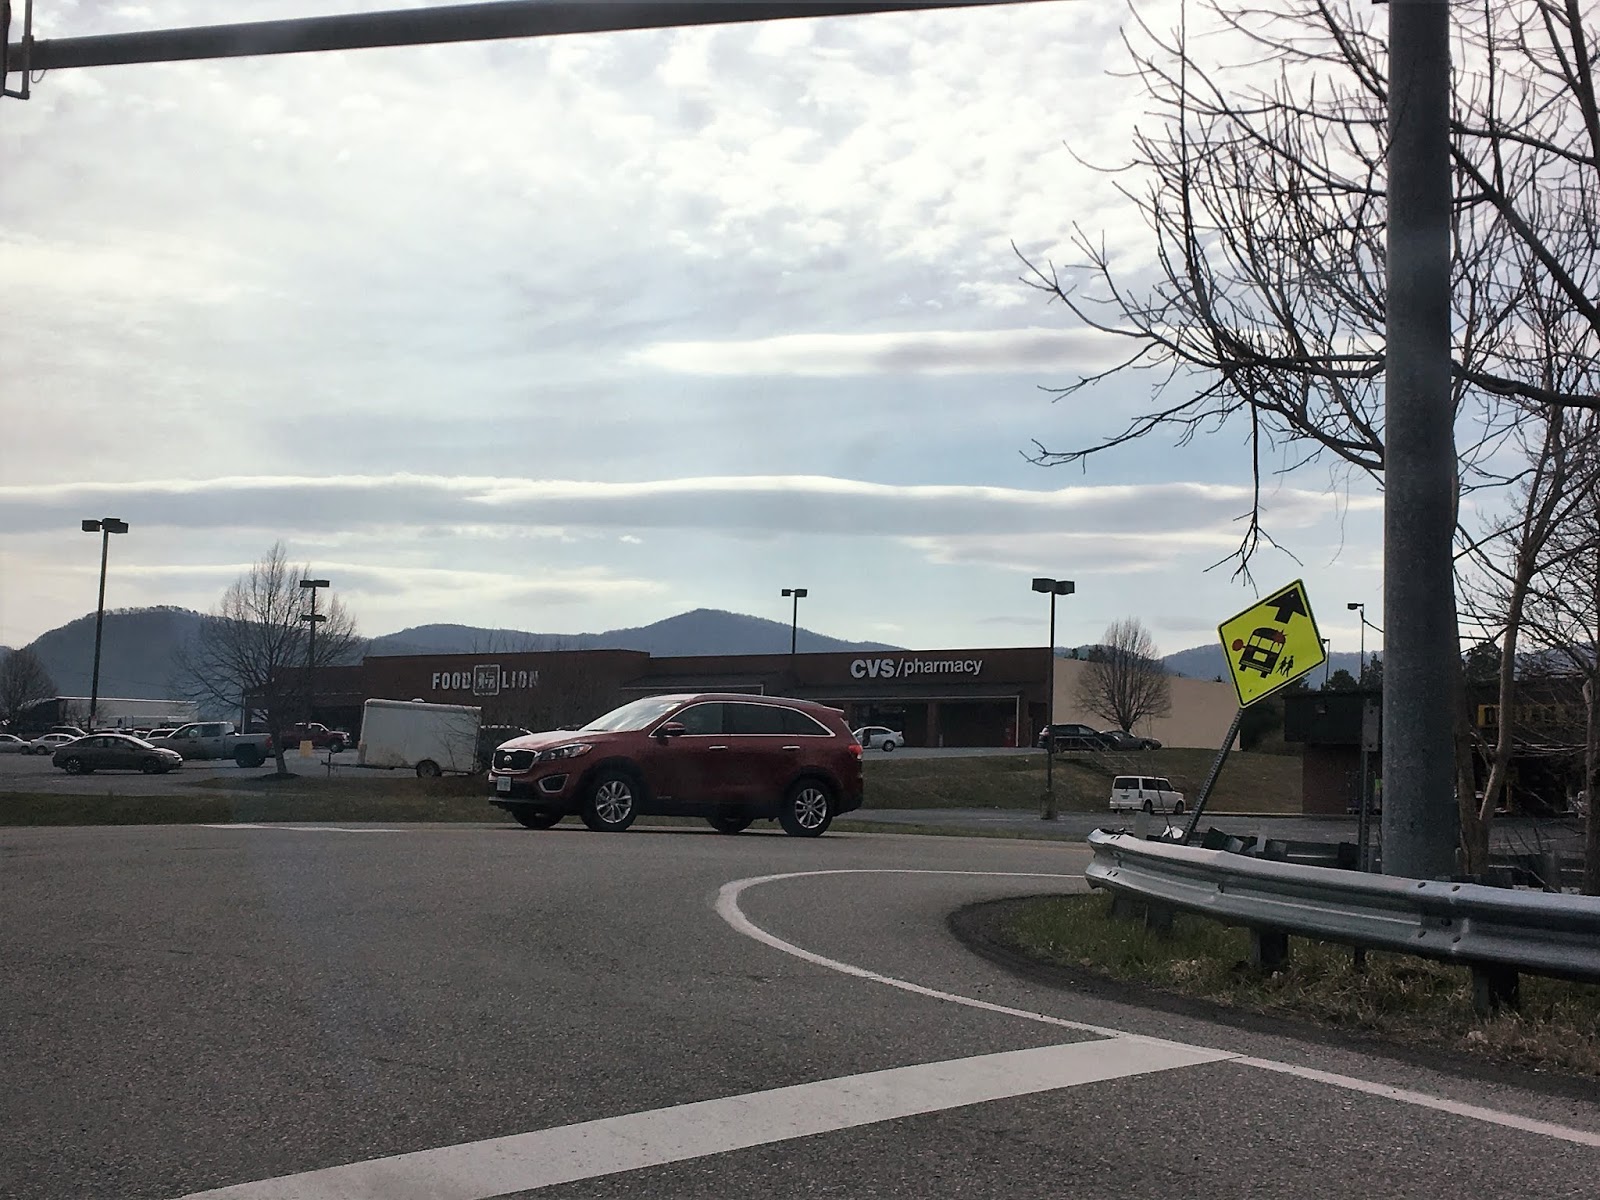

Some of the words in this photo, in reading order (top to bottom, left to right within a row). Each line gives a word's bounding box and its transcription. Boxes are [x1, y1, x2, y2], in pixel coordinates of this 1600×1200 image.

[850, 658, 983, 678] CVS/pharmacy
[432, 672, 472, 690] FOOD
[501, 670, 540, 689] LION
